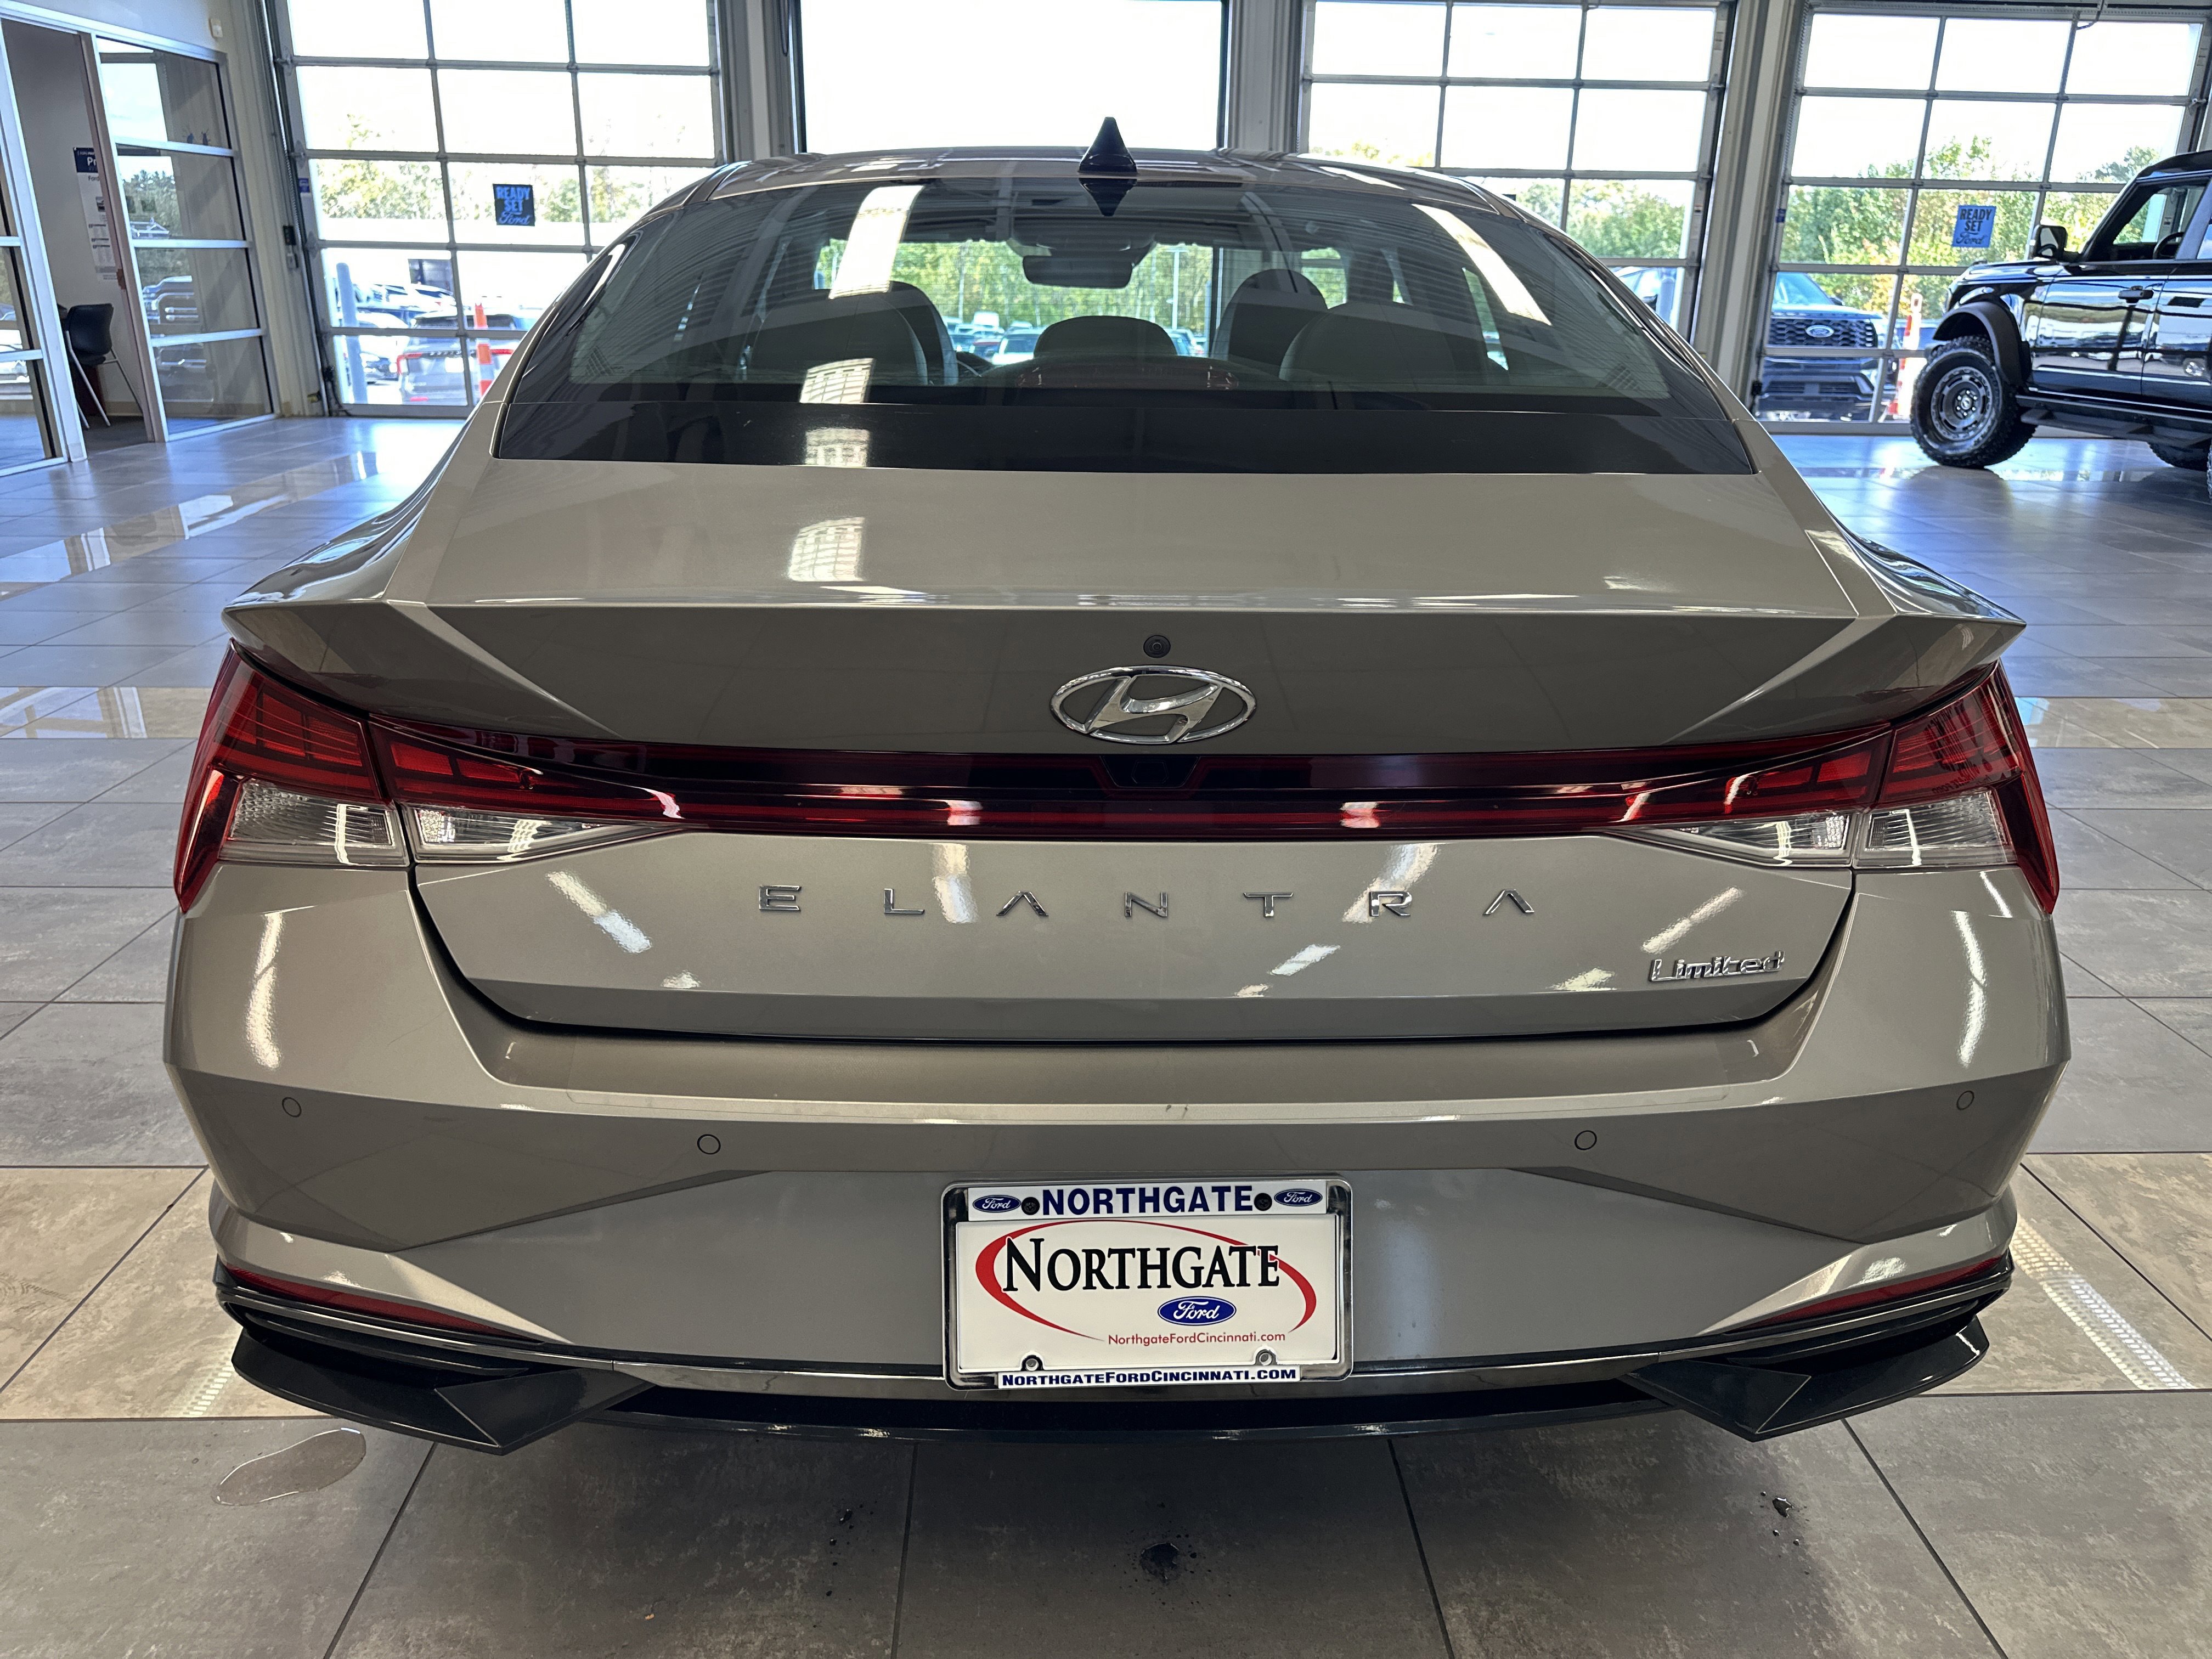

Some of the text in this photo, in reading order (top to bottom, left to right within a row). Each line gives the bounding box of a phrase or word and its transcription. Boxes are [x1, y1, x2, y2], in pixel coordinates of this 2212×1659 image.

[496, 187, 530, 200] READY
[504, 199, 523, 212] SET
[498, 211, 532, 224] Ford
[1960, 208, 1992, 220] READY
[1965, 220, 1983, 232] SET
[1956, 232, 1986, 245] Ford
[759, 884, 1535, 918] ELANTRA
[1649, 951, 1785, 982] Limited
[982, 1185, 1312, 1216] Ford NORTHGATE Ford
[1002, 1237, 1280, 1293] NORTHGATE
[1173, 1301, 1220, 1319] Ford
[1108, 1331, 1286, 1347] NorthgateFordCincinnati.com
